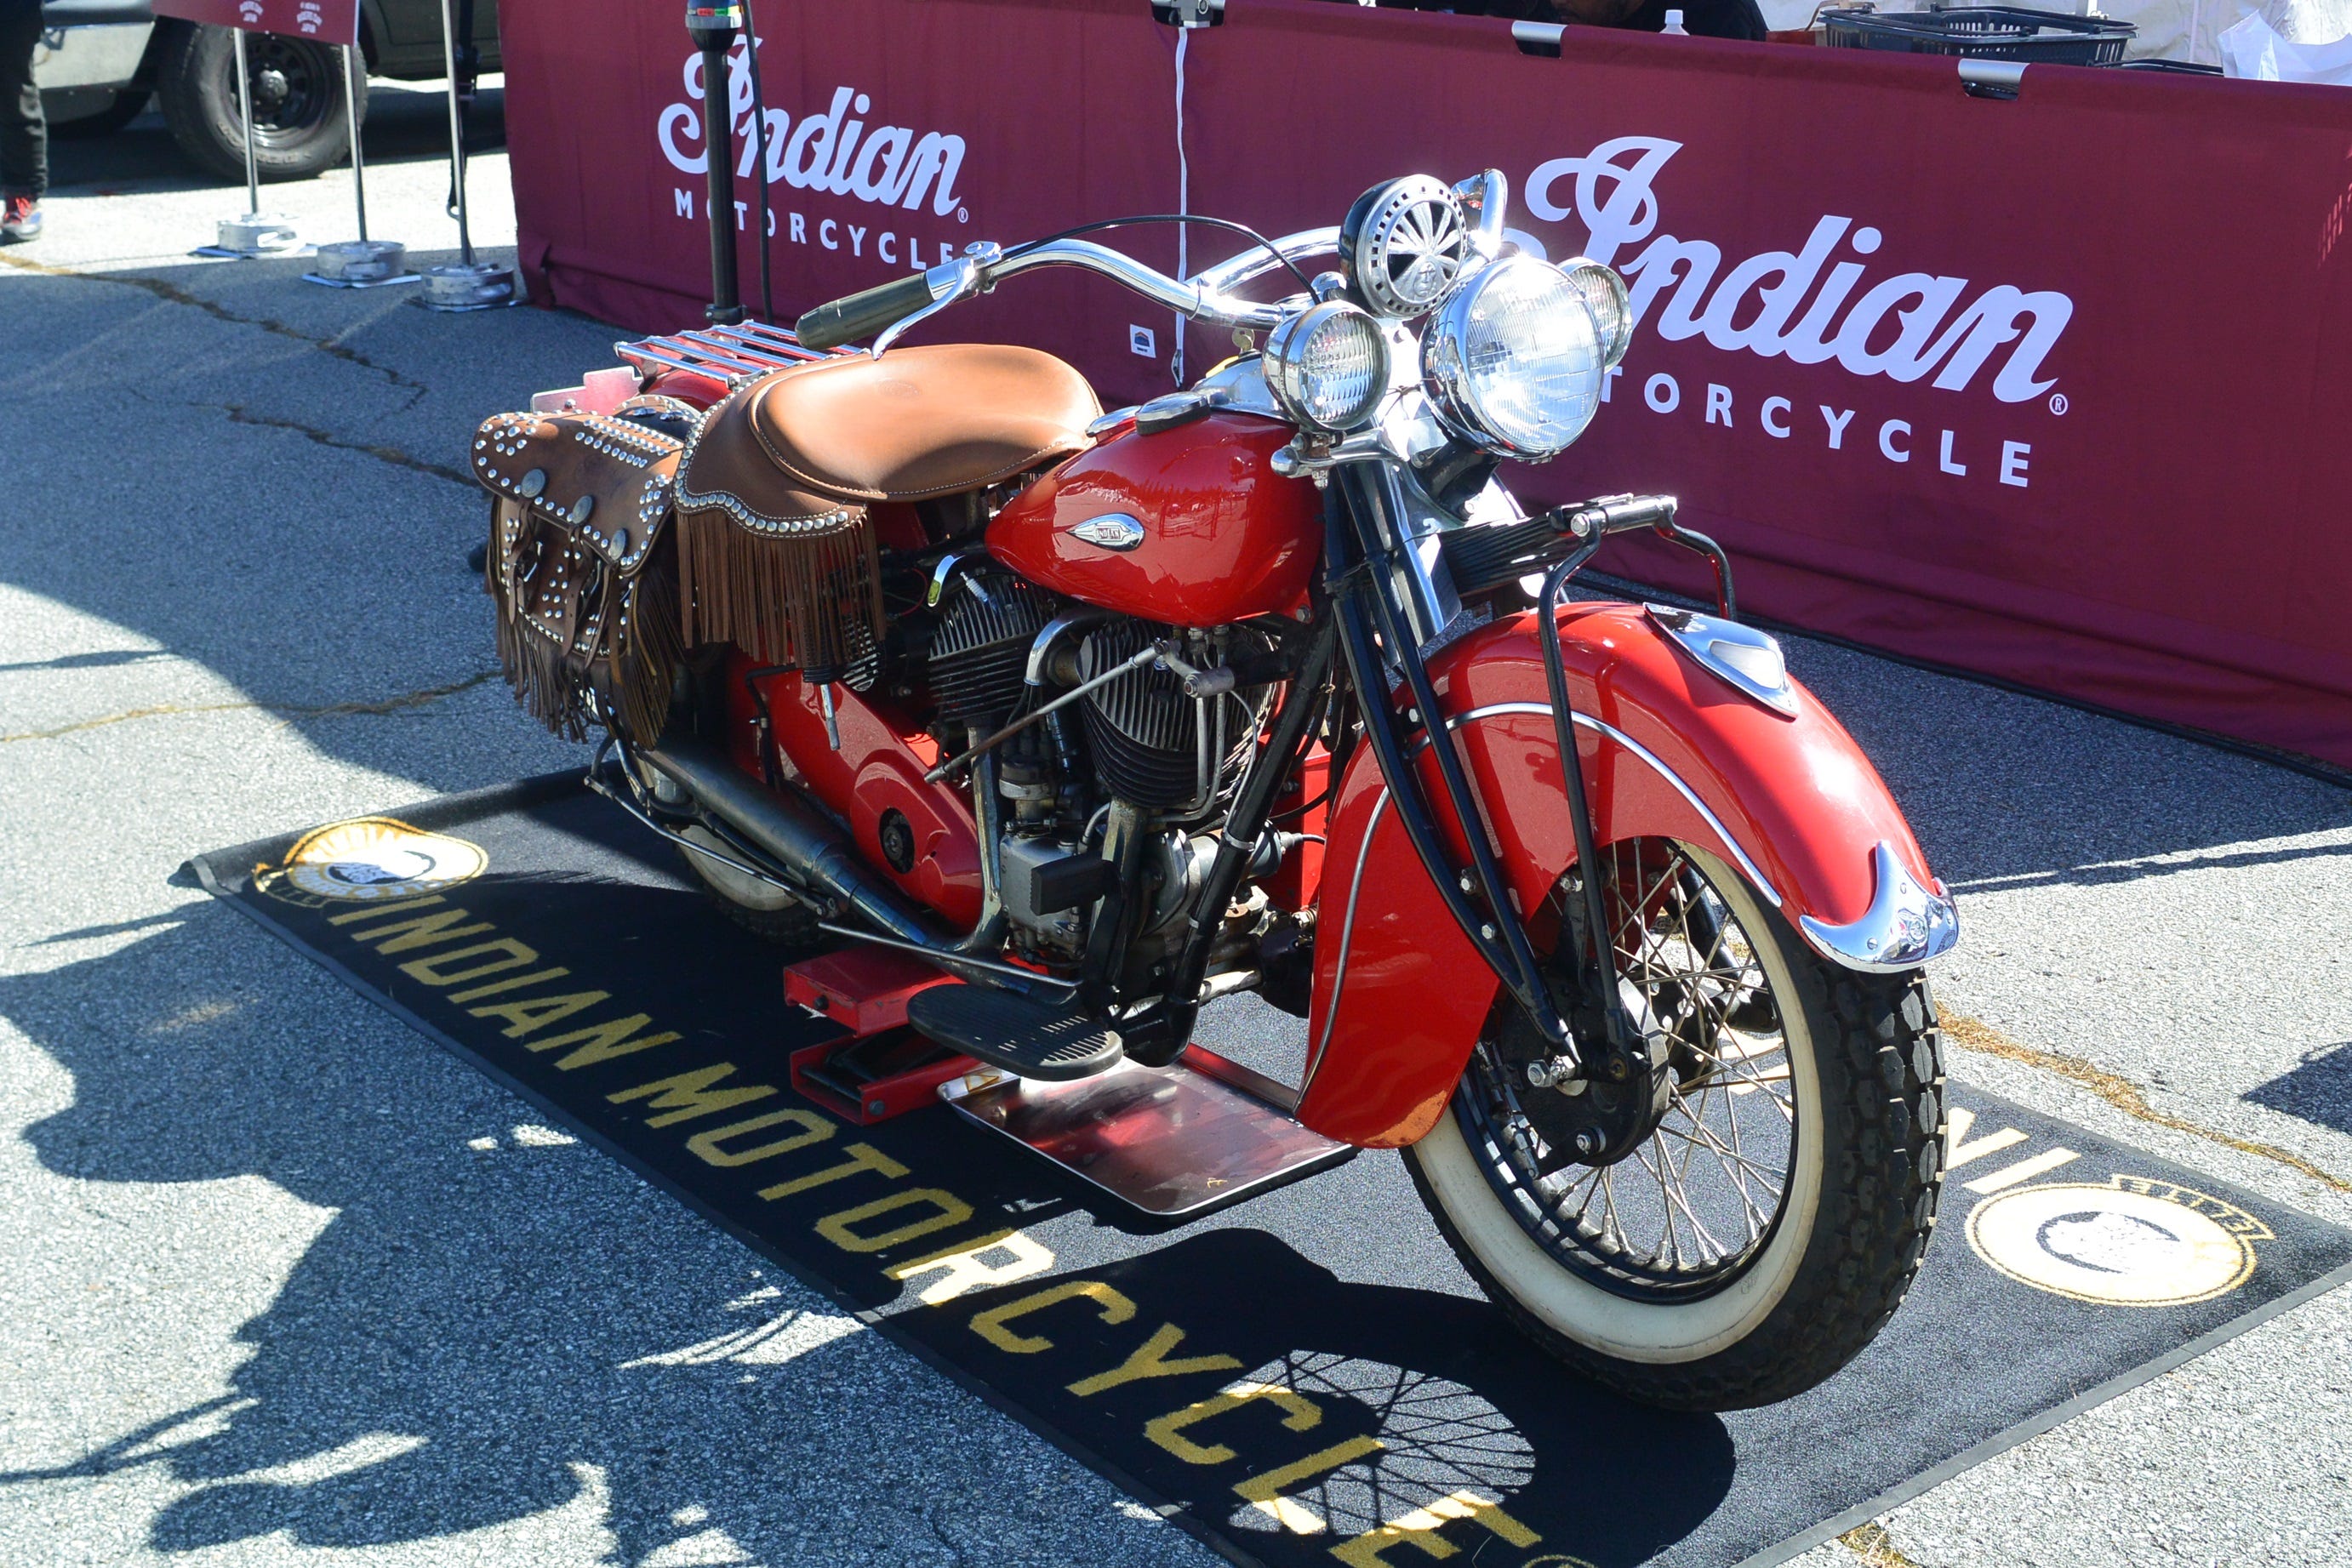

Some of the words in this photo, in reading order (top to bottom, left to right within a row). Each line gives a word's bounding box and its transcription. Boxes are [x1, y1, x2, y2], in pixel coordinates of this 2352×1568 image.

[658, 34, 966, 216] Indian
[1503, 136, 2074, 403] Indian
[328, 895, 682, 1071] INDIAN
[605, 1062, 1543, 1568] MOTORCYCLE
